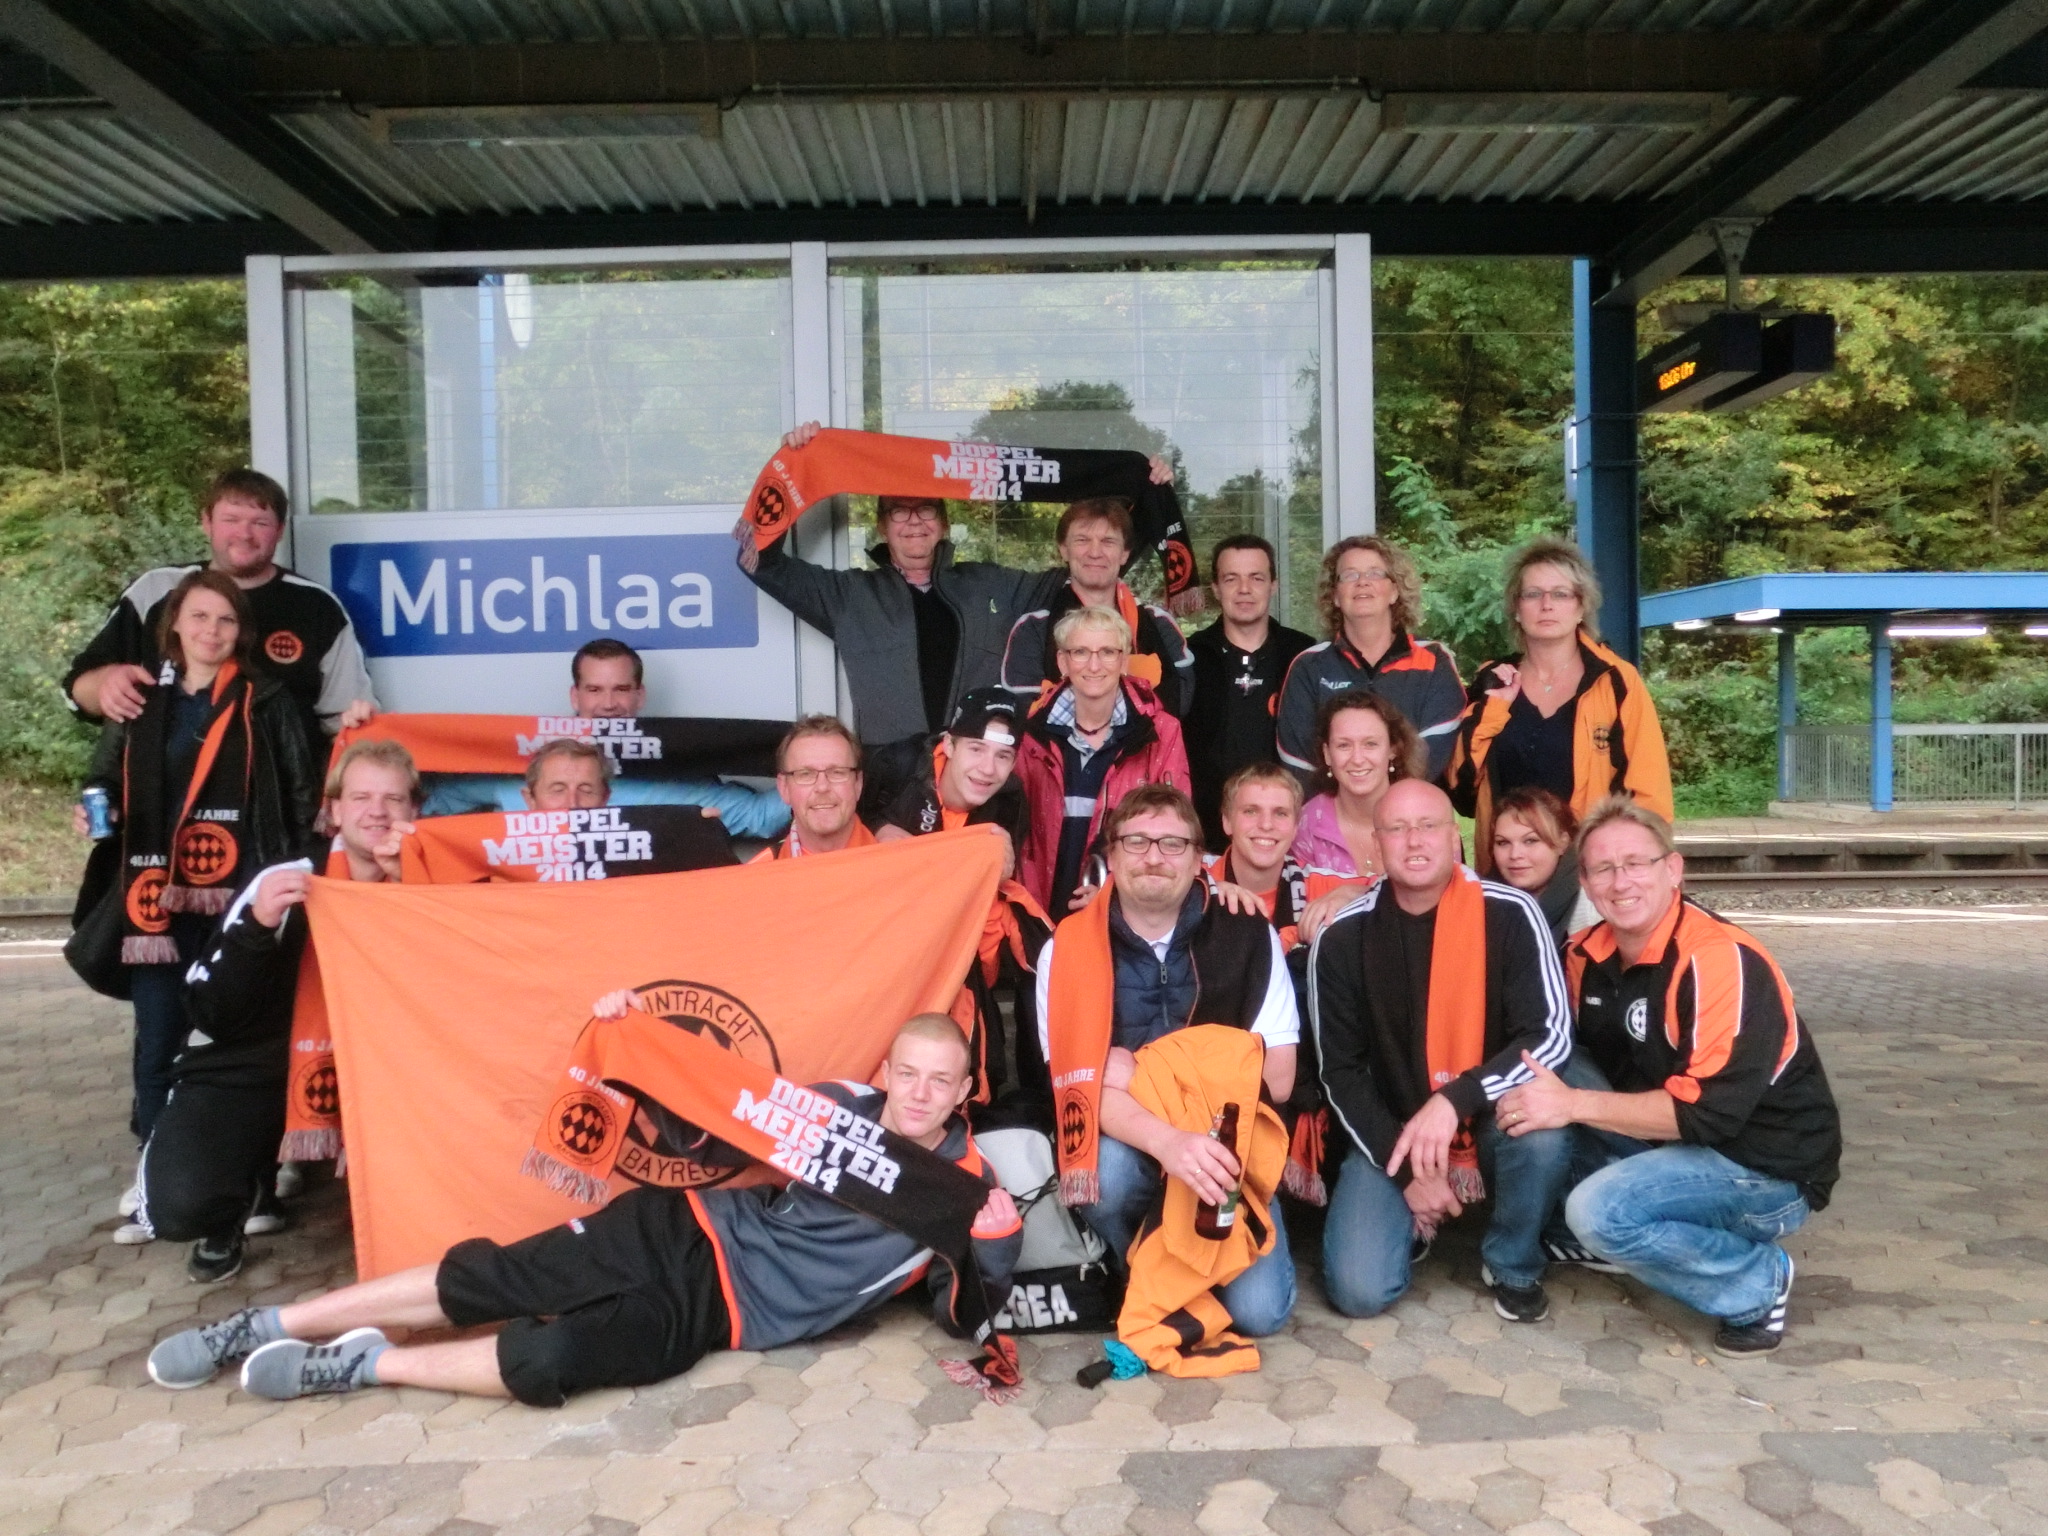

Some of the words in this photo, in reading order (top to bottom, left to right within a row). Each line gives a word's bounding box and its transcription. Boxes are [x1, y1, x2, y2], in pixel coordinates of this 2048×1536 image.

[950, 442, 1042, 460] DOPPEL
[932, 454, 1061, 483] MEISTER
[772, 459, 785, 473] 40
[781, 472, 805, 509] JAHRE
[970, 479, 1023, 501] 2014
[379, 554, 714, 637] Michlaa
[538, 717, 643, 736] DOPPEL
[515, 733, 662, 760] MTER
[504, 808, 630, 836] DOPPEL
[482, 830, 652, 866] MEISTER
[536, 861, 606, 883] 2014
[643, 990, 758, 1043] INTRACHT
[296, 1040, 314, 1052] 40
[568, 1066, 586, 1082] 40
[1054, 1076, 1063, 1089] 40
[1064, 1068, 1096, 1087] JAHRE
[1434, 1071, 1449, 1083] 40
[768, 1077, 886, 1155] DOPPEL
[732, 1088, 901, 1195] MEISTER
[768, 1141, 842, 1194] 2014
